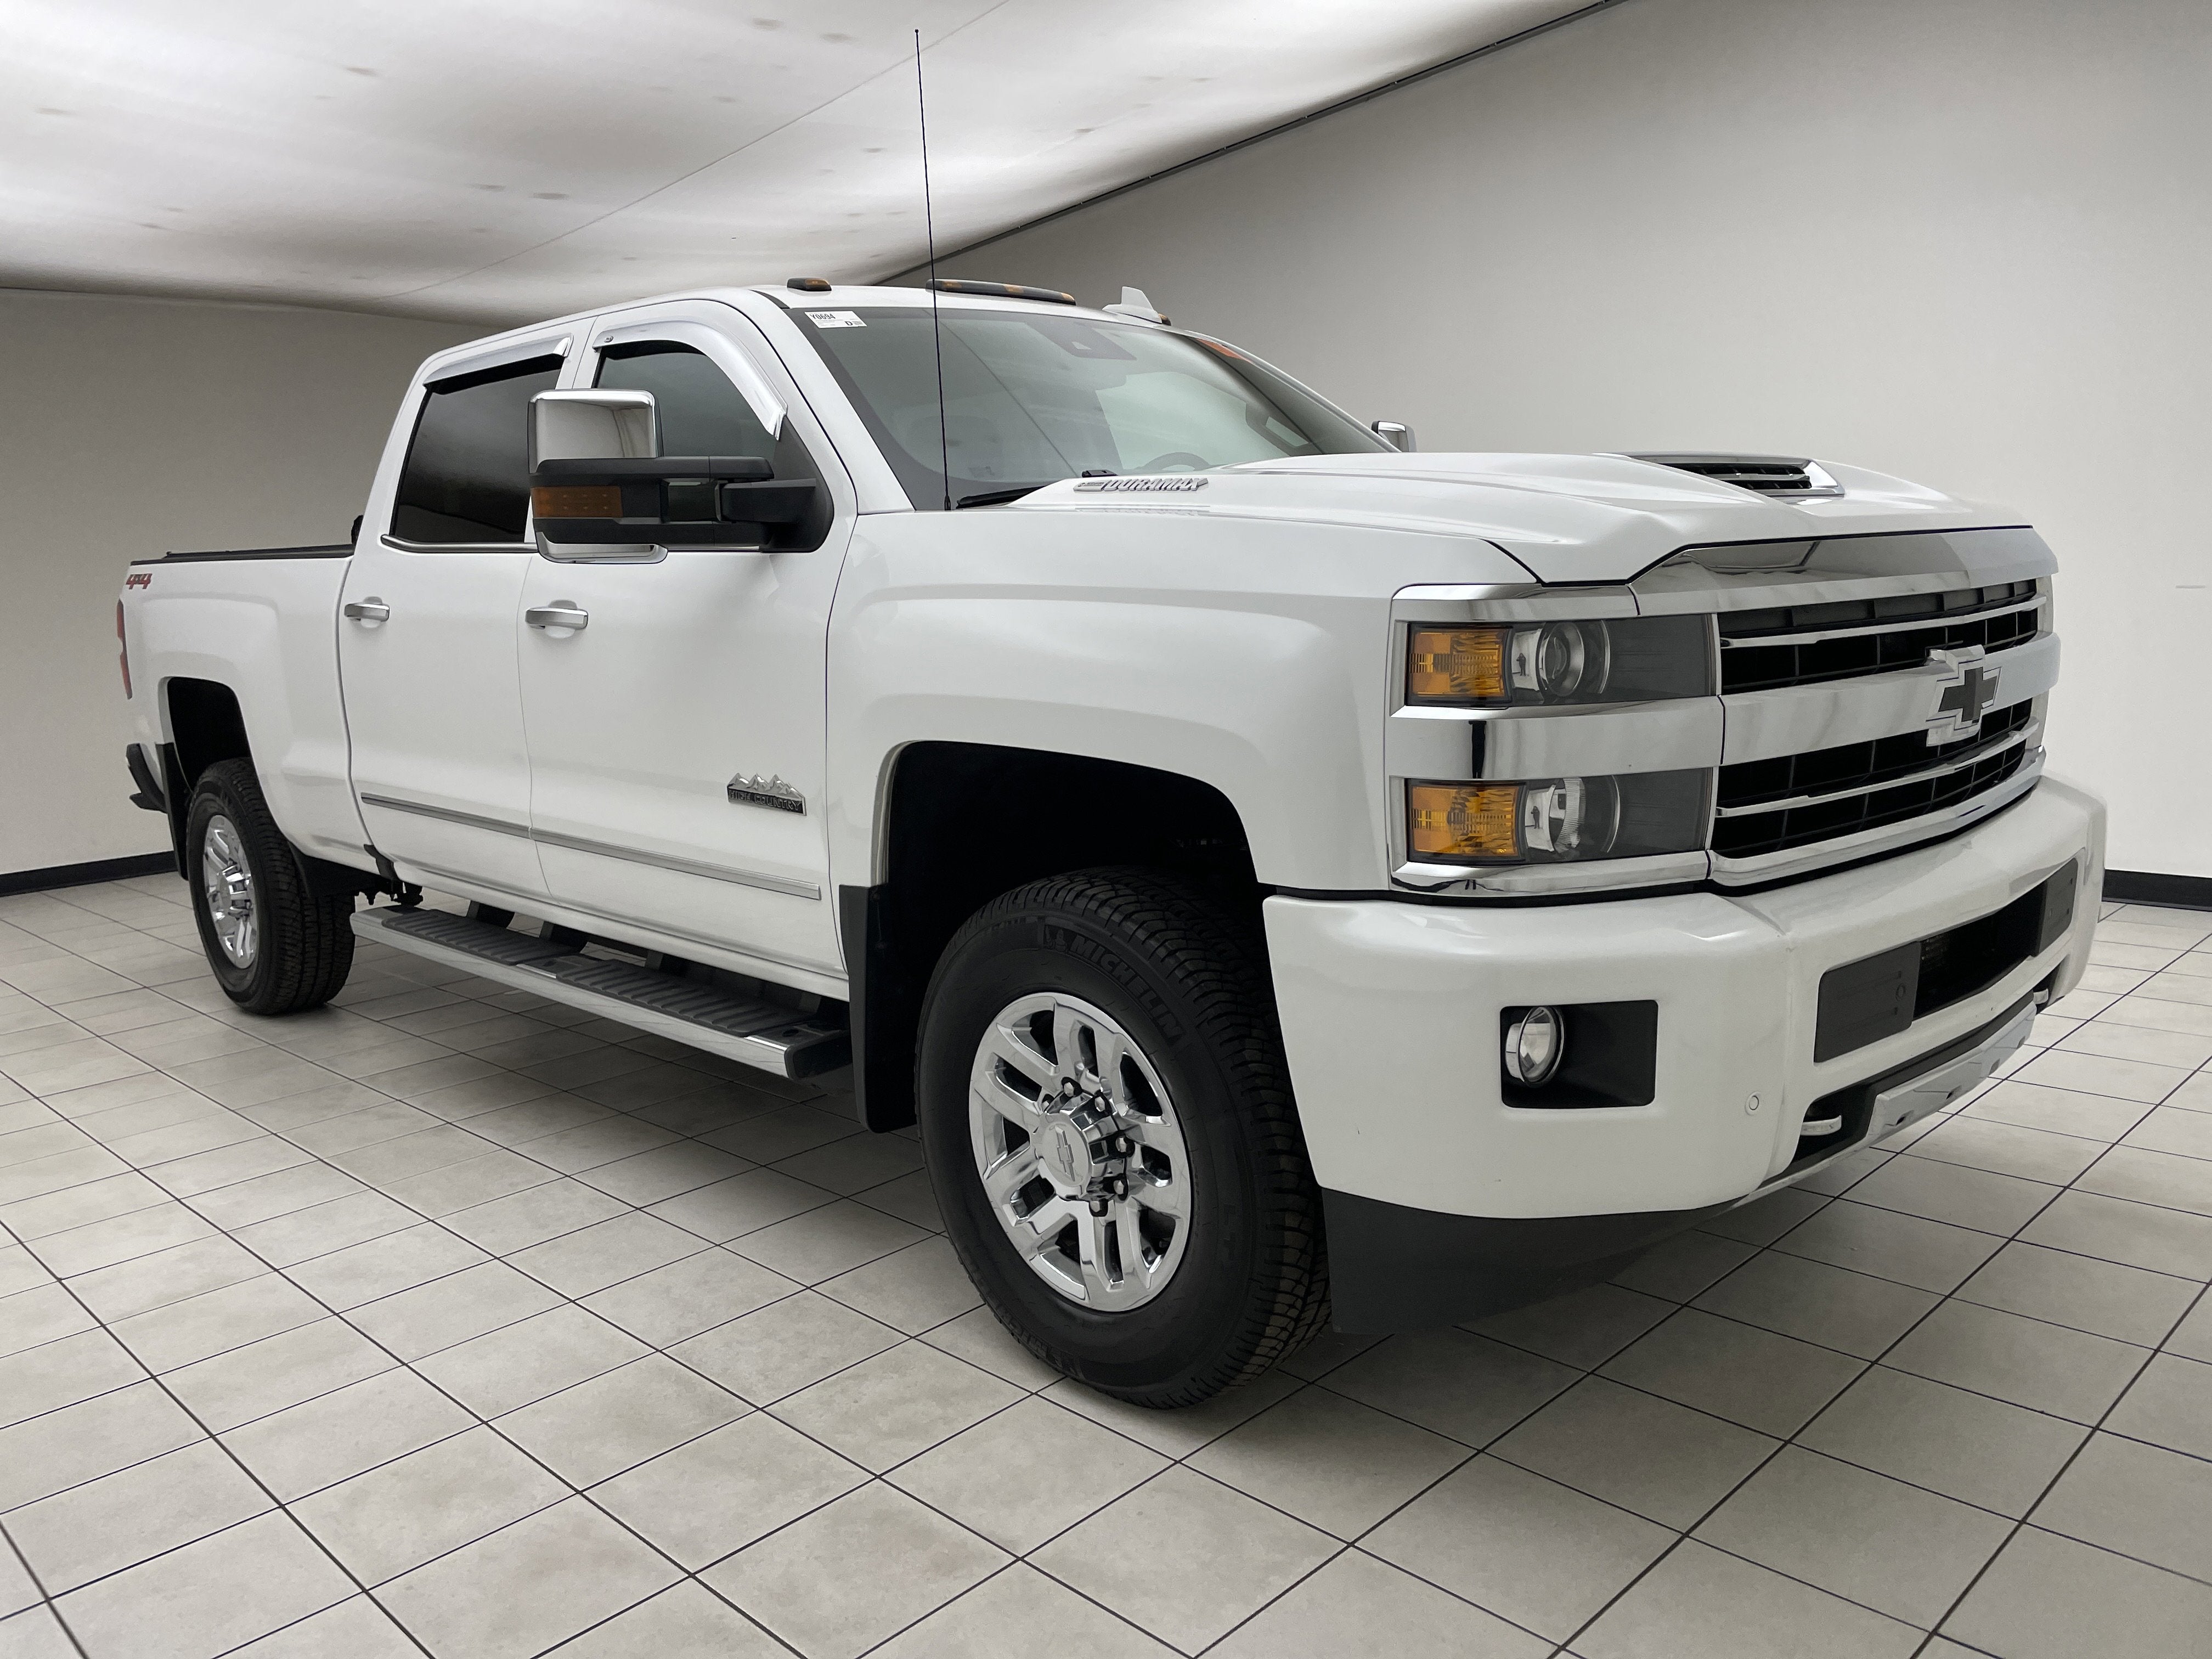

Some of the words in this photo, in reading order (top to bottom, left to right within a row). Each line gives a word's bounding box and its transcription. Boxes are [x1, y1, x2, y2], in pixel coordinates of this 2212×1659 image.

[1103, 478, 1209, 492] DURAMAX
[730, 790, 751, 801] HIGH
[755, 795, 800, 810] COUNTRY
[1070, 933, 1183, 1038] MICHELIN
